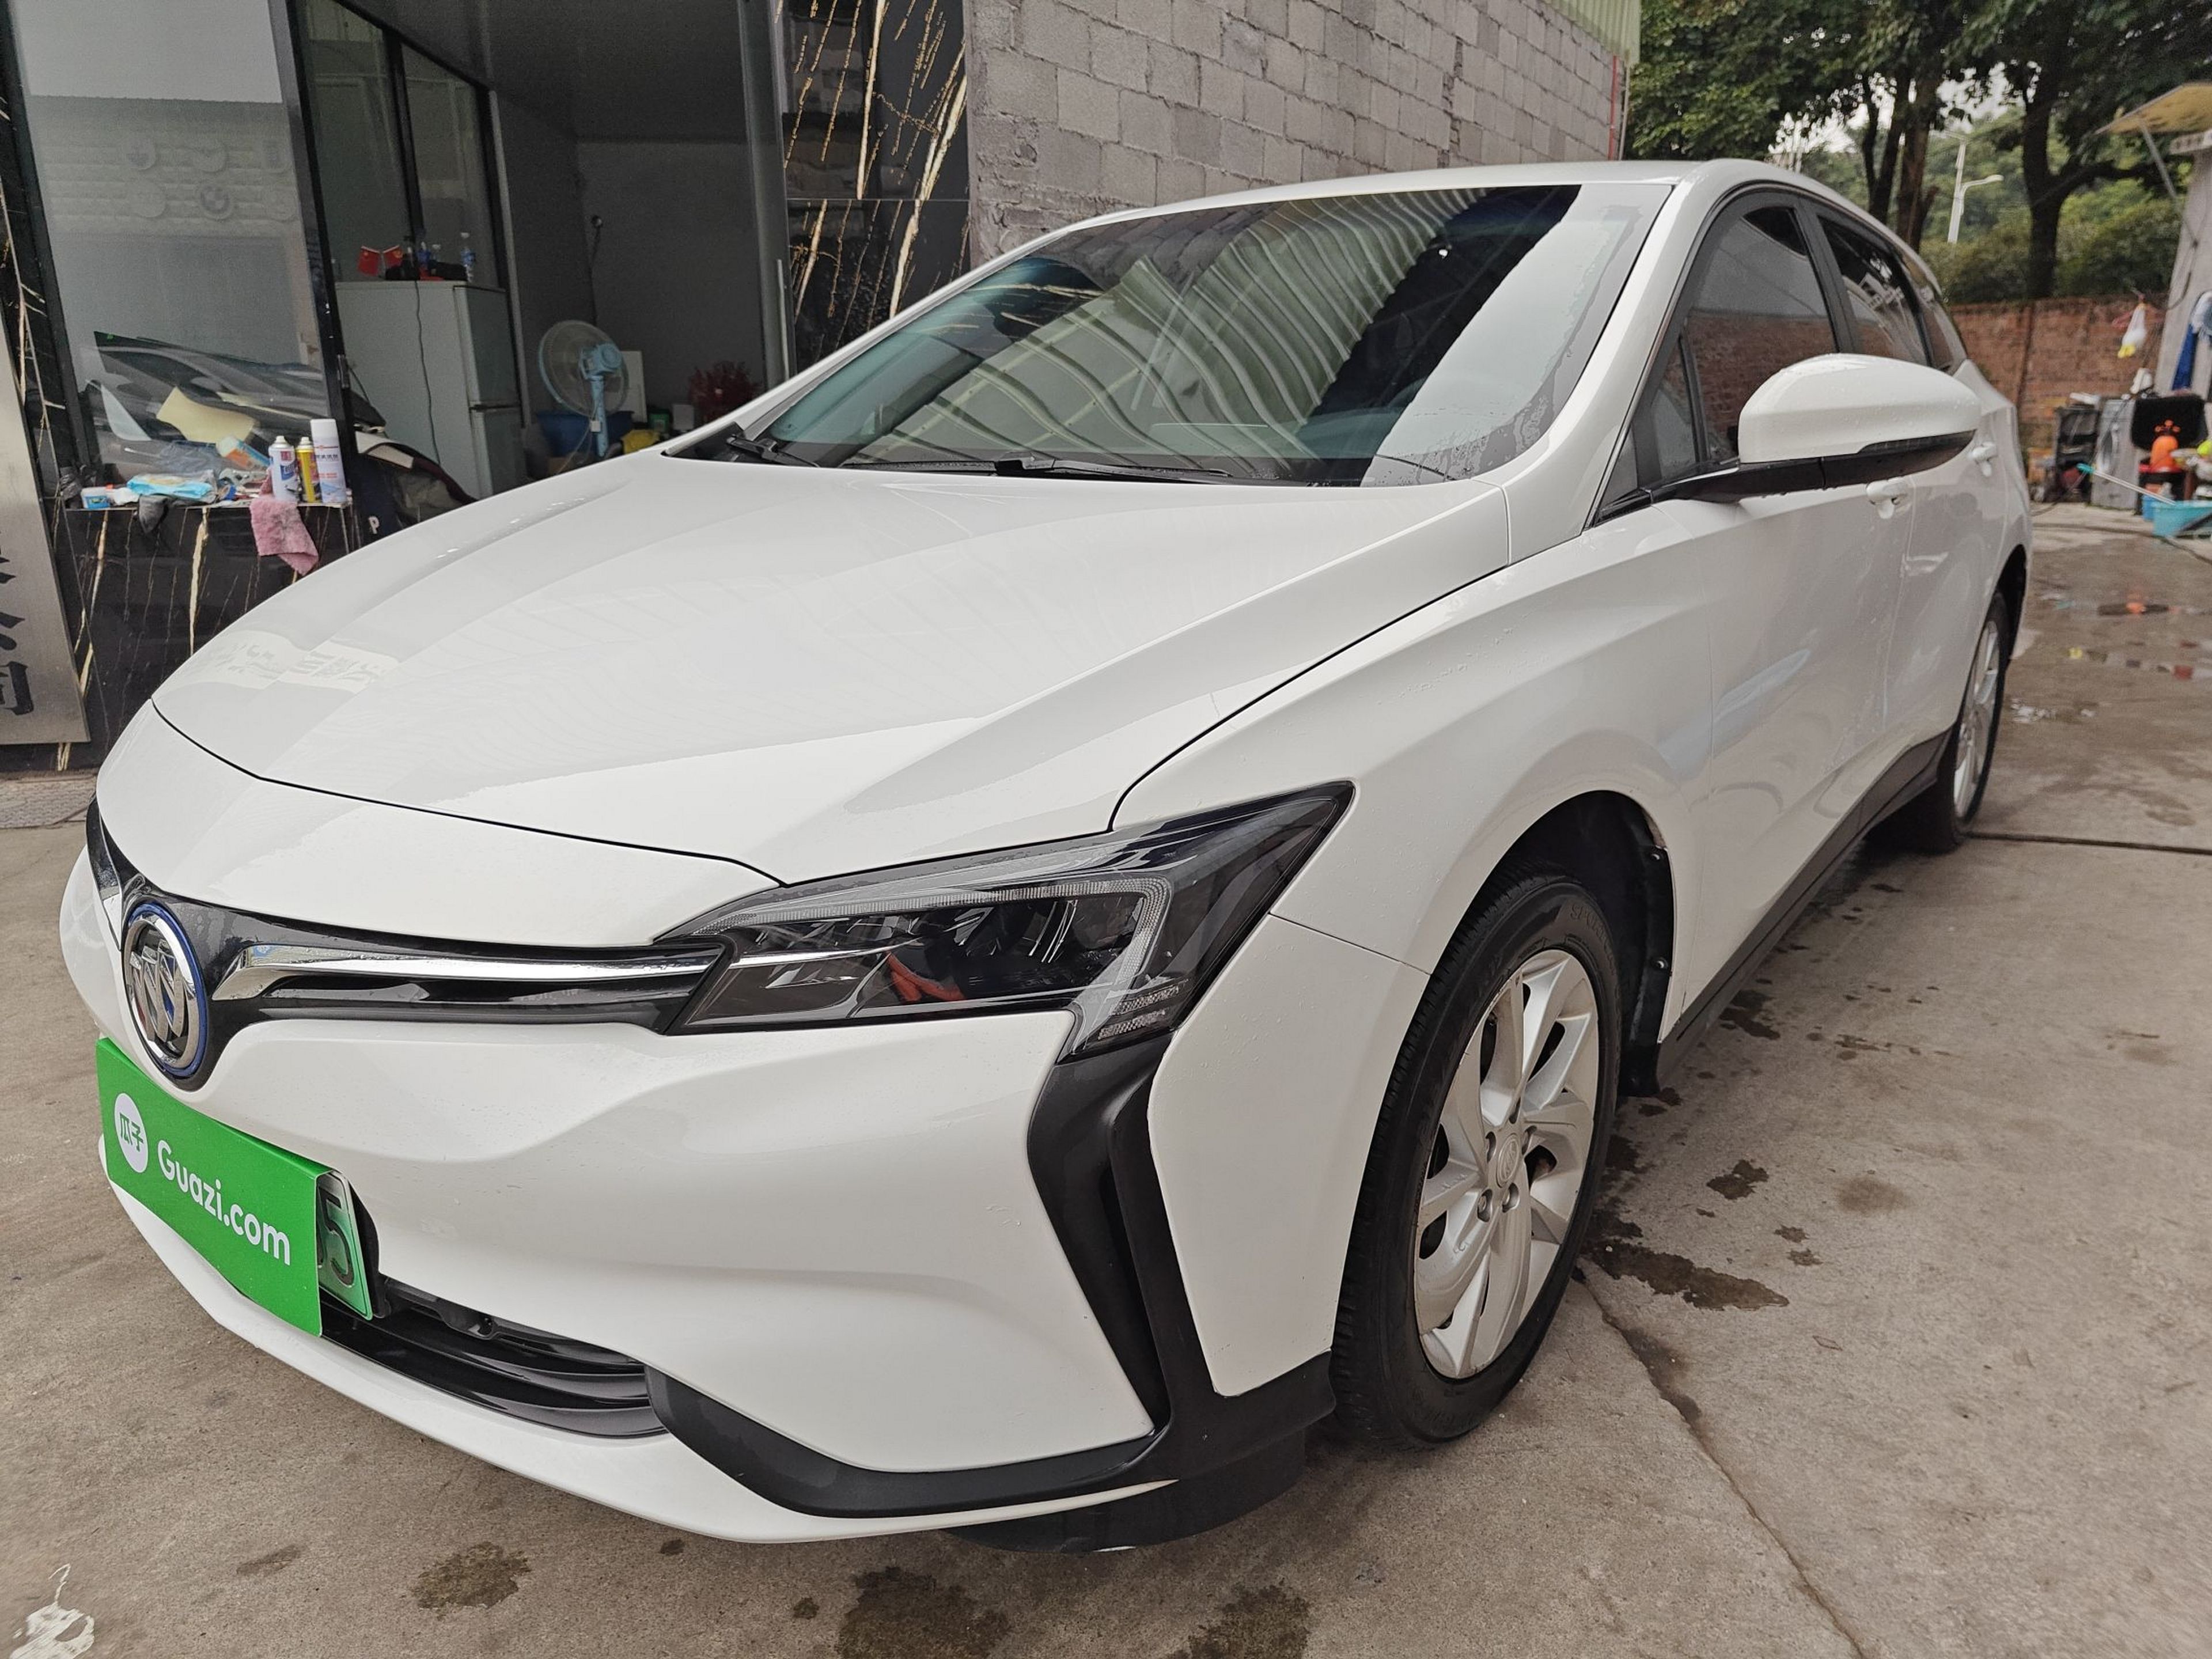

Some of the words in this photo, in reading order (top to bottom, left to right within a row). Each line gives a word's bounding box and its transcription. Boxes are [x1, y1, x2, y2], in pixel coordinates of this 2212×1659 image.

[120, 1112, 144, 1152] 瓜子
[158, 1140, 290, 1266] Guazi.com
[317, 1187, 354, 1287] 5
